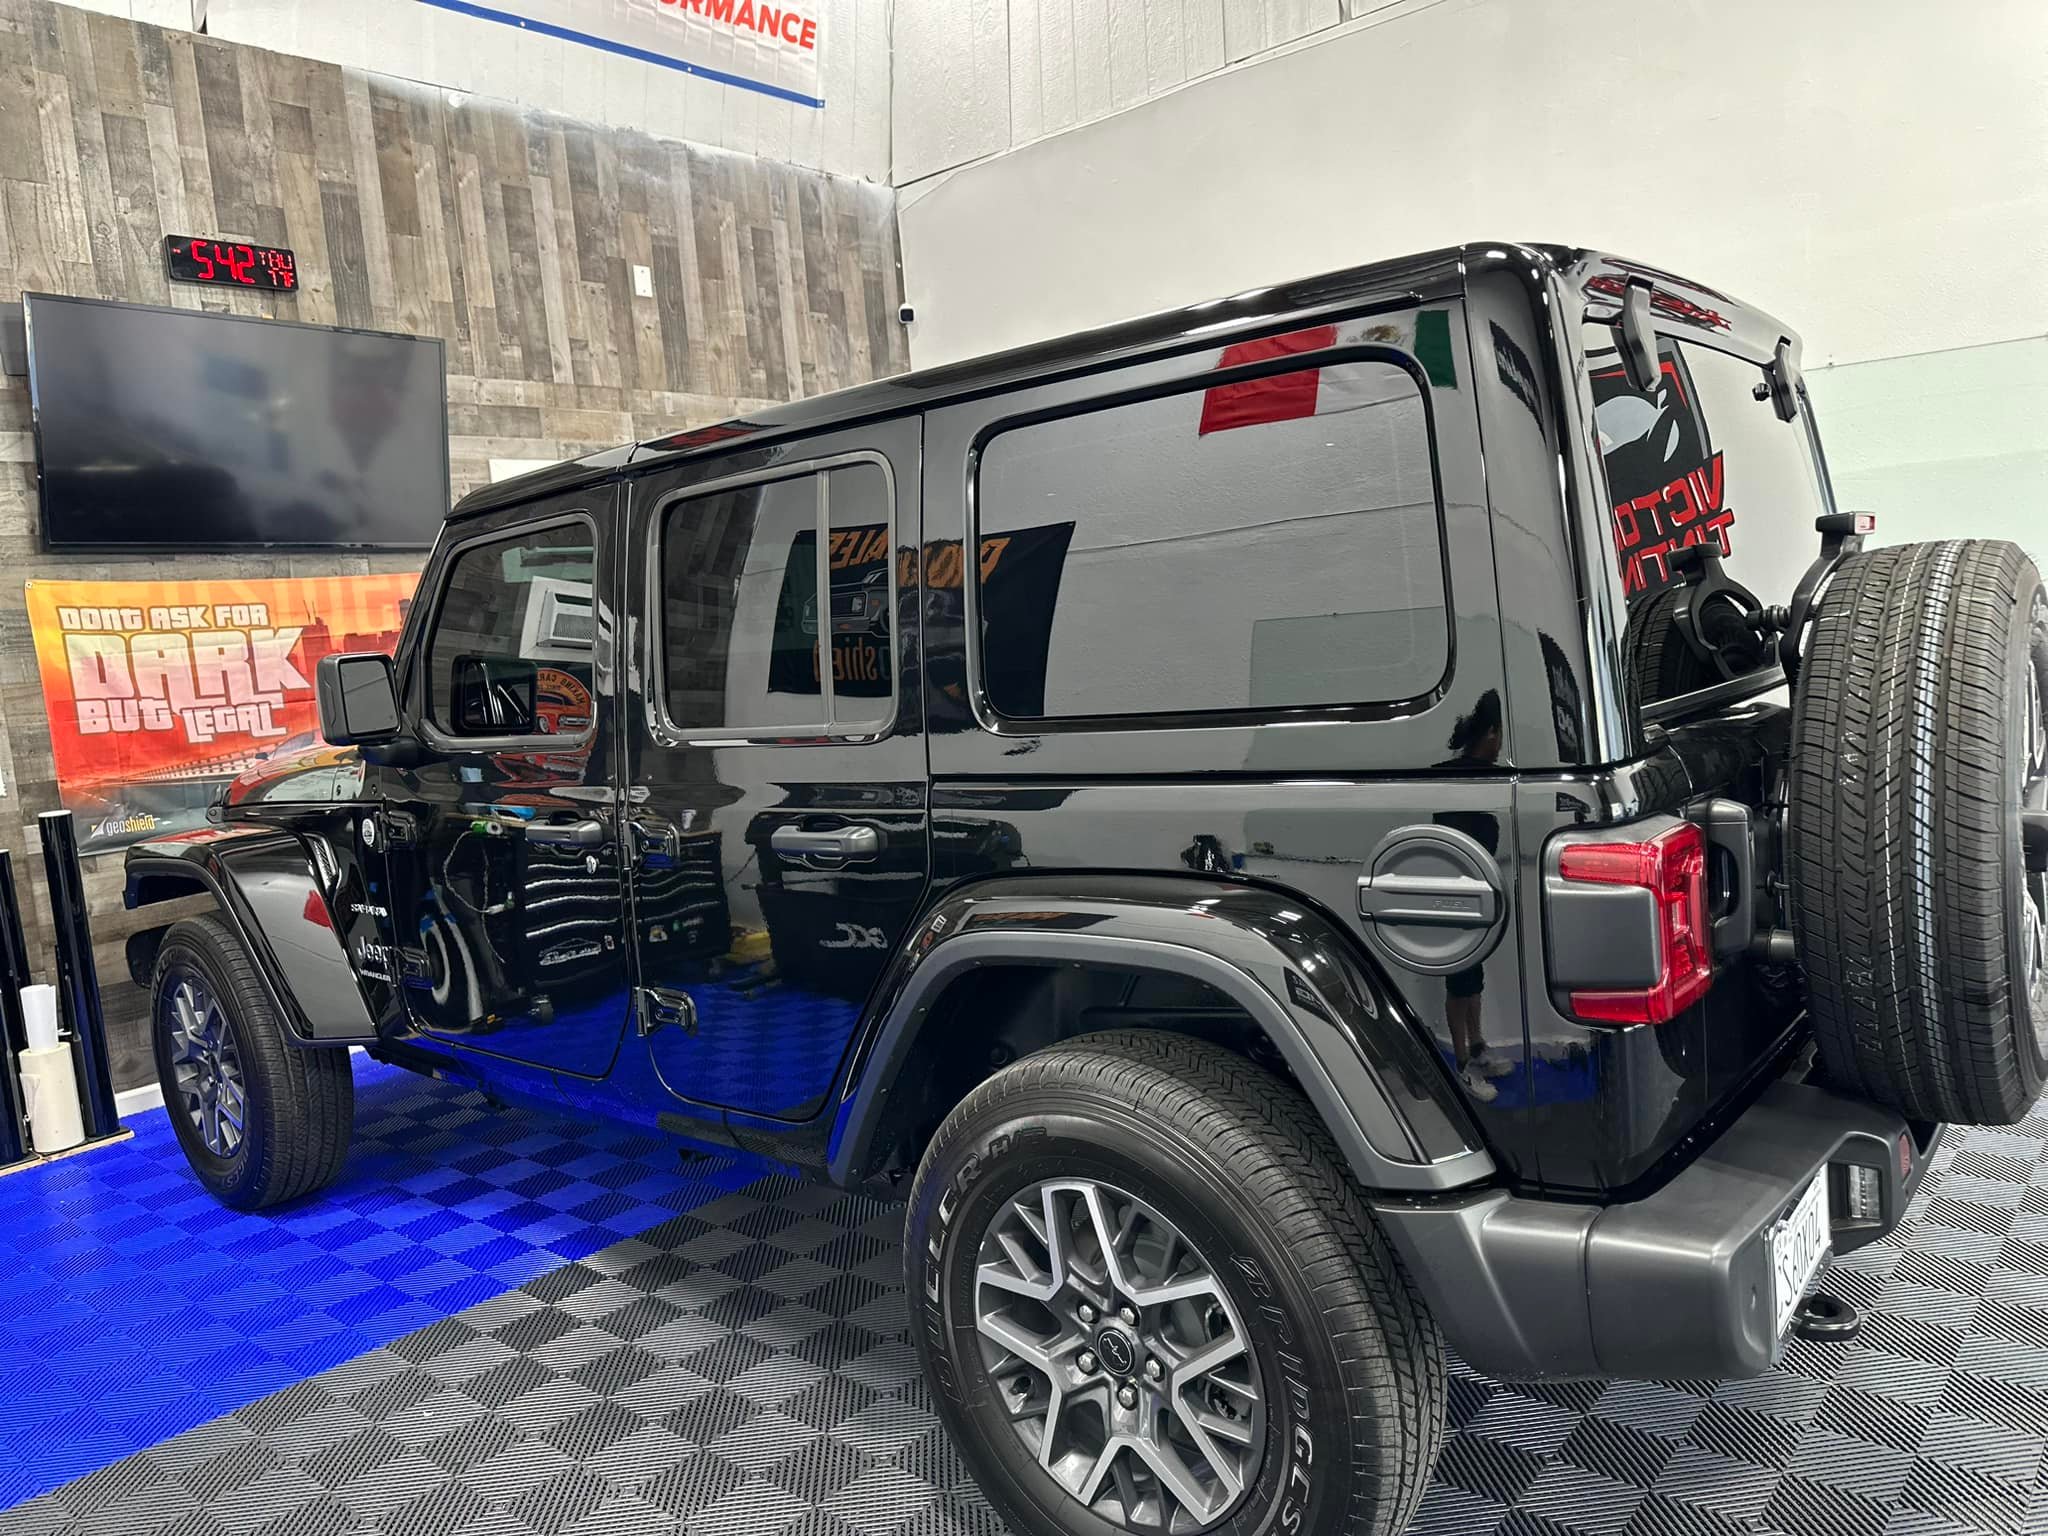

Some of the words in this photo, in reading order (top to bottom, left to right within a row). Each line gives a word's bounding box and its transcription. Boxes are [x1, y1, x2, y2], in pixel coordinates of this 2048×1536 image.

[660, 0, 816, 49] MANCE
[150, 604, 211, 630] ASK
[213, 603, 269, 628] FOR
[64, 627, 311, 711] DARK
[76, 699, 175, 735] BUT
[181, 702, 288, 743] LEGAL
[106, 814, 155, 836] geoshield
[1229, 1255, 1313, 1536] BRIDGES
